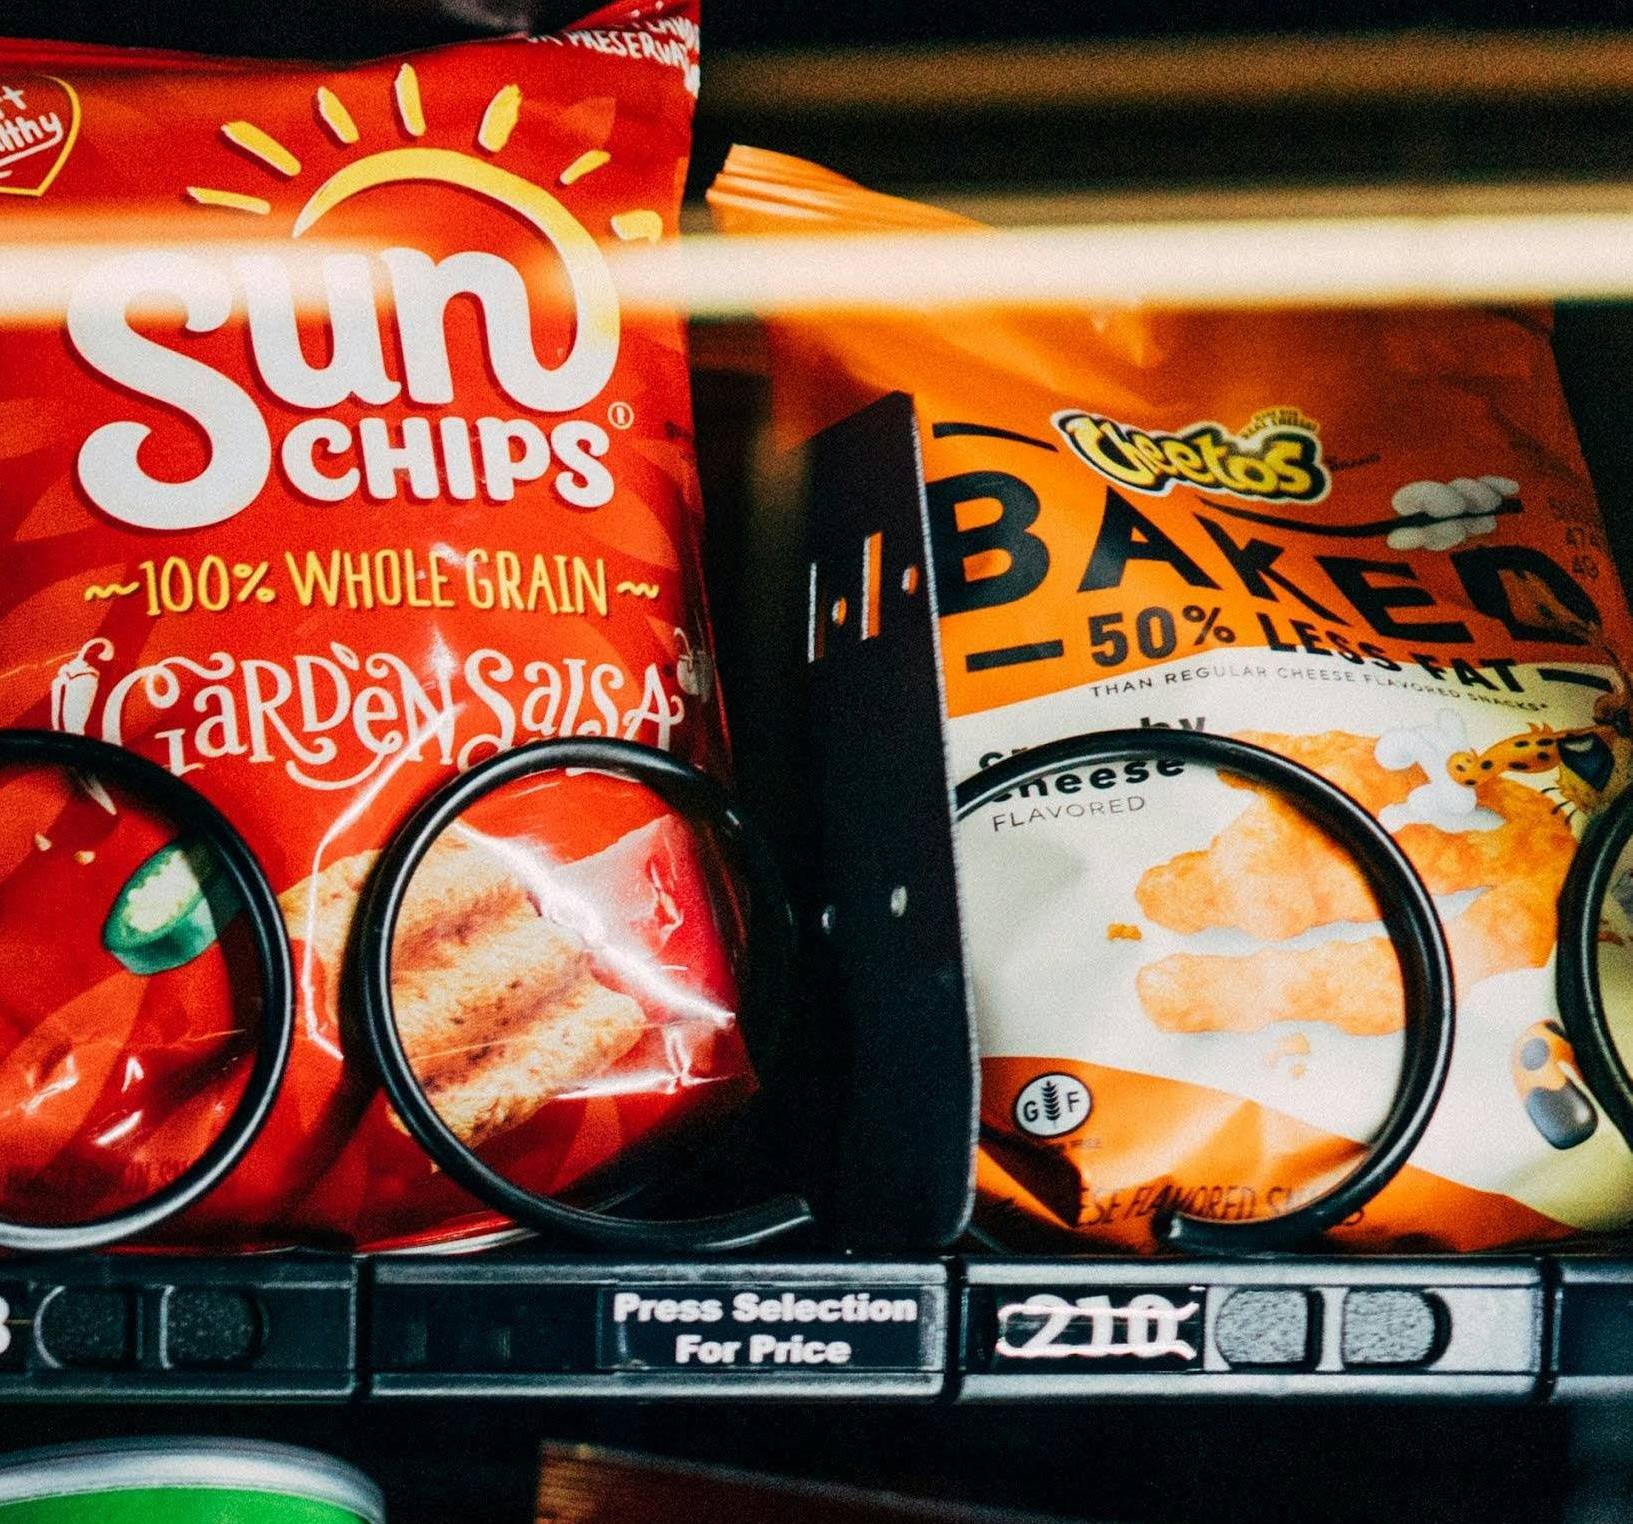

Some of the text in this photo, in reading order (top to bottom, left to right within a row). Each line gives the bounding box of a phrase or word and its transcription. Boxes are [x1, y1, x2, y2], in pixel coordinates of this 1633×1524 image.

[66, 245, 621, 530] Sun
[281, 416, 616, 509] CHIPS
[144, 548, 610, 617] 100% WHOLE GRAIN
[931, 470, 1601, 646] BAKED
[1089, 604, 1529, 695] 50% LESS FAT
[1089, 677, 1154, 698] THAN
[1165, 664, 1268, 684] REGULAR
[1276, 666, 1357, 684] CHEESE
[992, 795, 1145, 832] FLAVORED
[614, 1291, 917, 1322] Press Selection
[1021, 1292, 1178, 1360] 210
[675, 1334, 852, 1364] For Price
